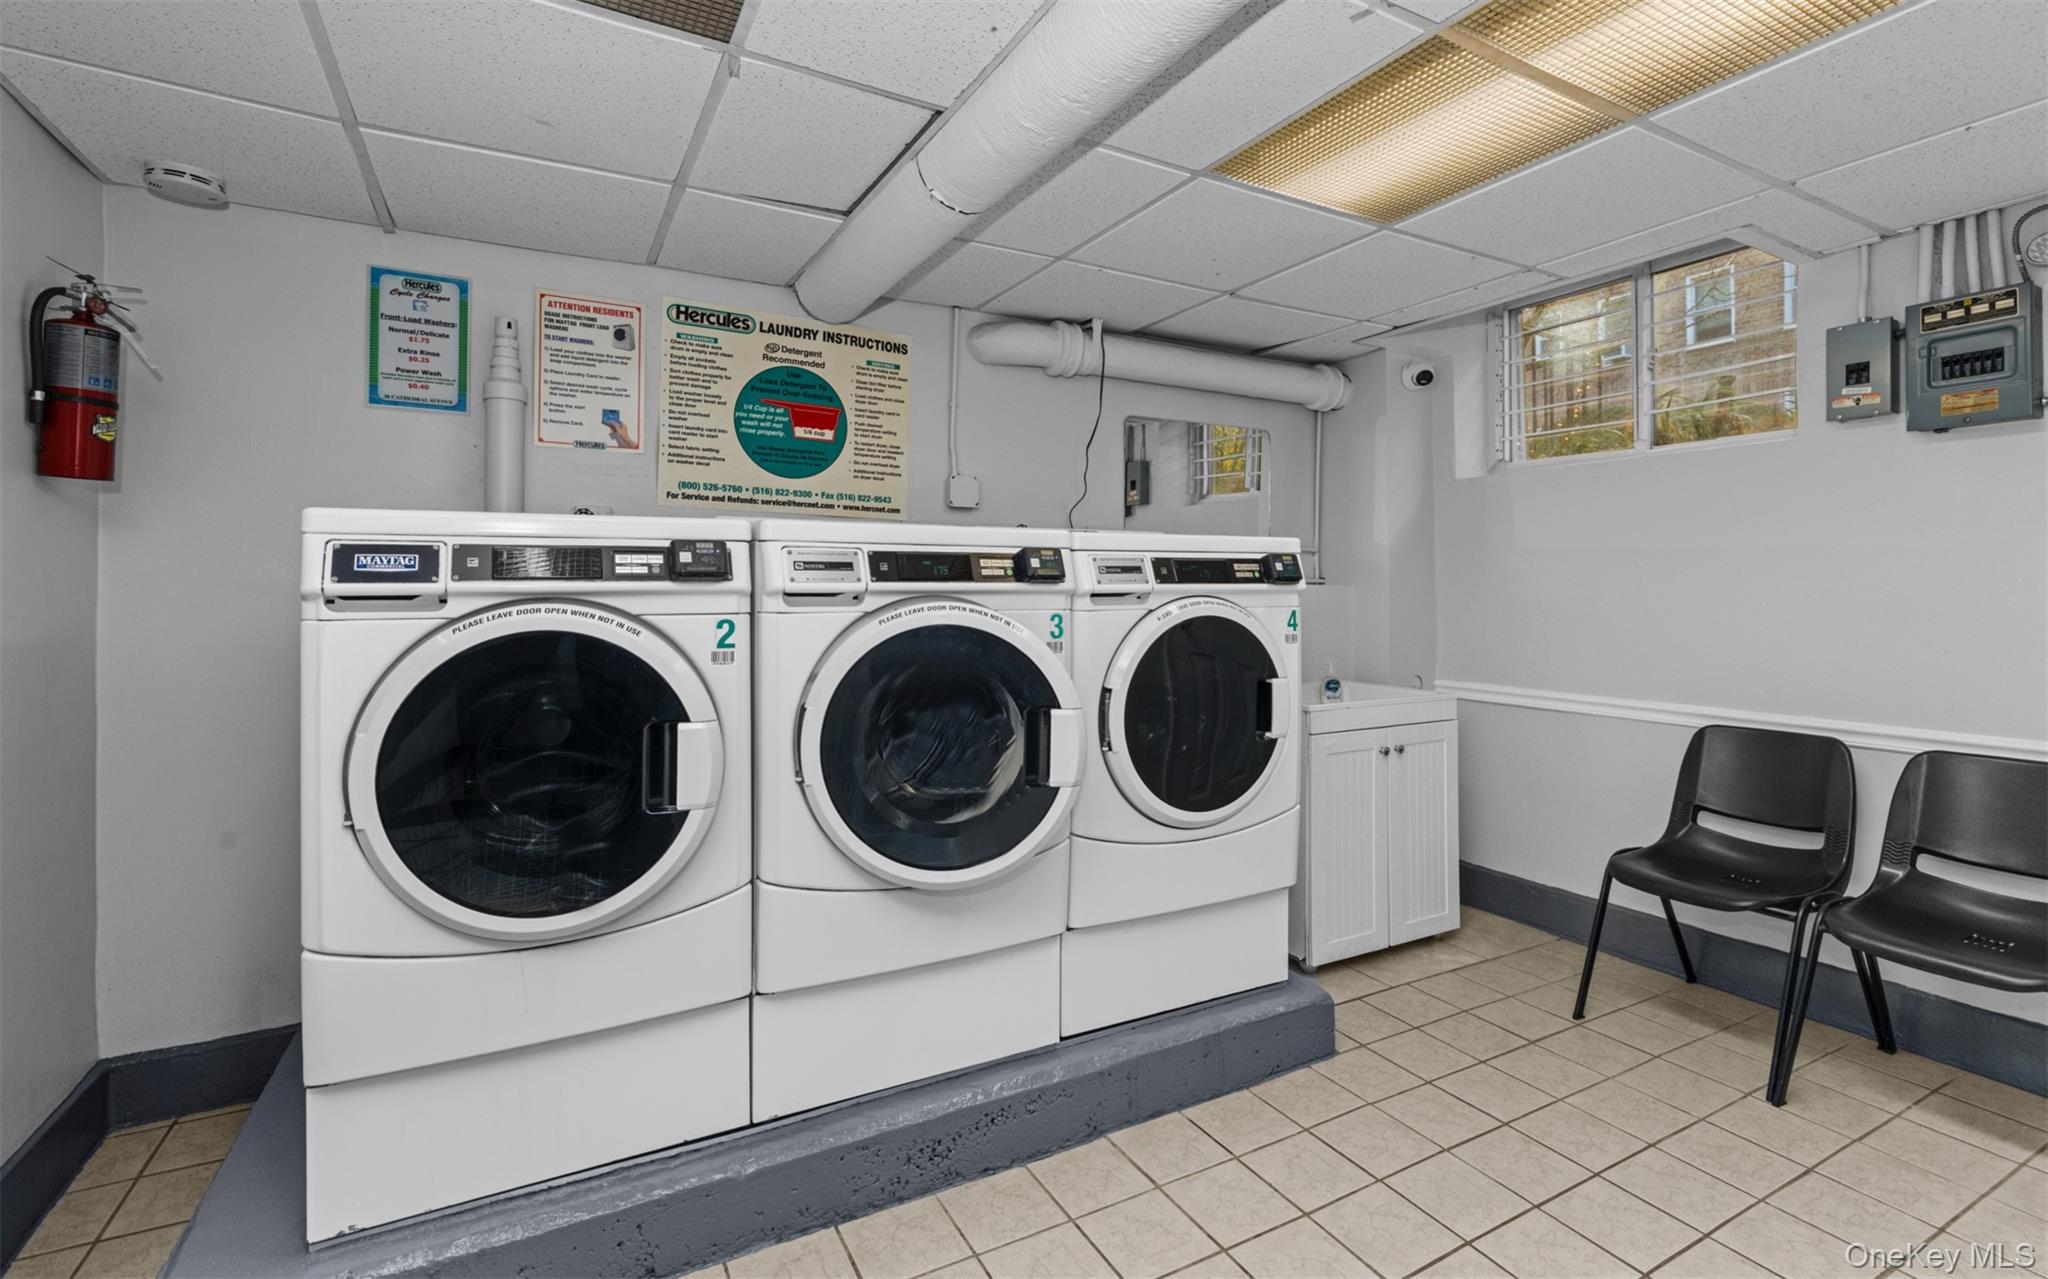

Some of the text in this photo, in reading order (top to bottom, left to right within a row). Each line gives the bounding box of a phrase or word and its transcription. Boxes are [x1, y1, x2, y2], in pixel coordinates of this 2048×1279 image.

[404, 278, 440, 291] Hercules
[417, 292, 450, 302] Charges
[548, 300, 634, 319] ATTENTION RESIDENTS
[381, 313, 457, 328] Front-Load Washers:
[562, 313, 597, 322] INSTRUCTIONS
[388, 326, 450, 338] Normal/Delicate
[675, 305, 909, 356] Hercules LAUNDRY INSTRUCTIONS
[680, 334, 715, 342] WASHING
[781, 346, 822, 358] Detergent
[762, 354, 825, 369] Recommended
[751, 386, 780, 394] Prevent
[780, 379, 816, 390] Detergent
[754, 405, 768, 413] Cup
[757, 429, 786, 438] properly.
[575, 440, 605, 449] Hercules
[678, 481, 701, 492] (800)
[703, 483, 743, 494] 526-5760
[752, 486, 773, 496] (516)
[775, 488, 812, 499] 822-9300
[836, 492, 856, 502] (516)
[858, 493, 892, 504] 822-9543
[666, 491, 901, 515] For Service and Refunds: service@hercnet.com www.hercnet.com
[359, 556, 414, 565] MAYTAG
[452, 607, 642, 637] PLEASE LEAVE DOOR OPEN WHEN NOT IN USE
[878, 612, 902, 626] PLEASE
[904, 606, 925, 617] LEAVE
[968, 608, 988, 617] WHEN
[990, 614, 1003, 623] NOT
[1287, 610, 1298, 631] 4
[1050, 614, 1064, 639] 3
[716, 619, 736, 649] 2
